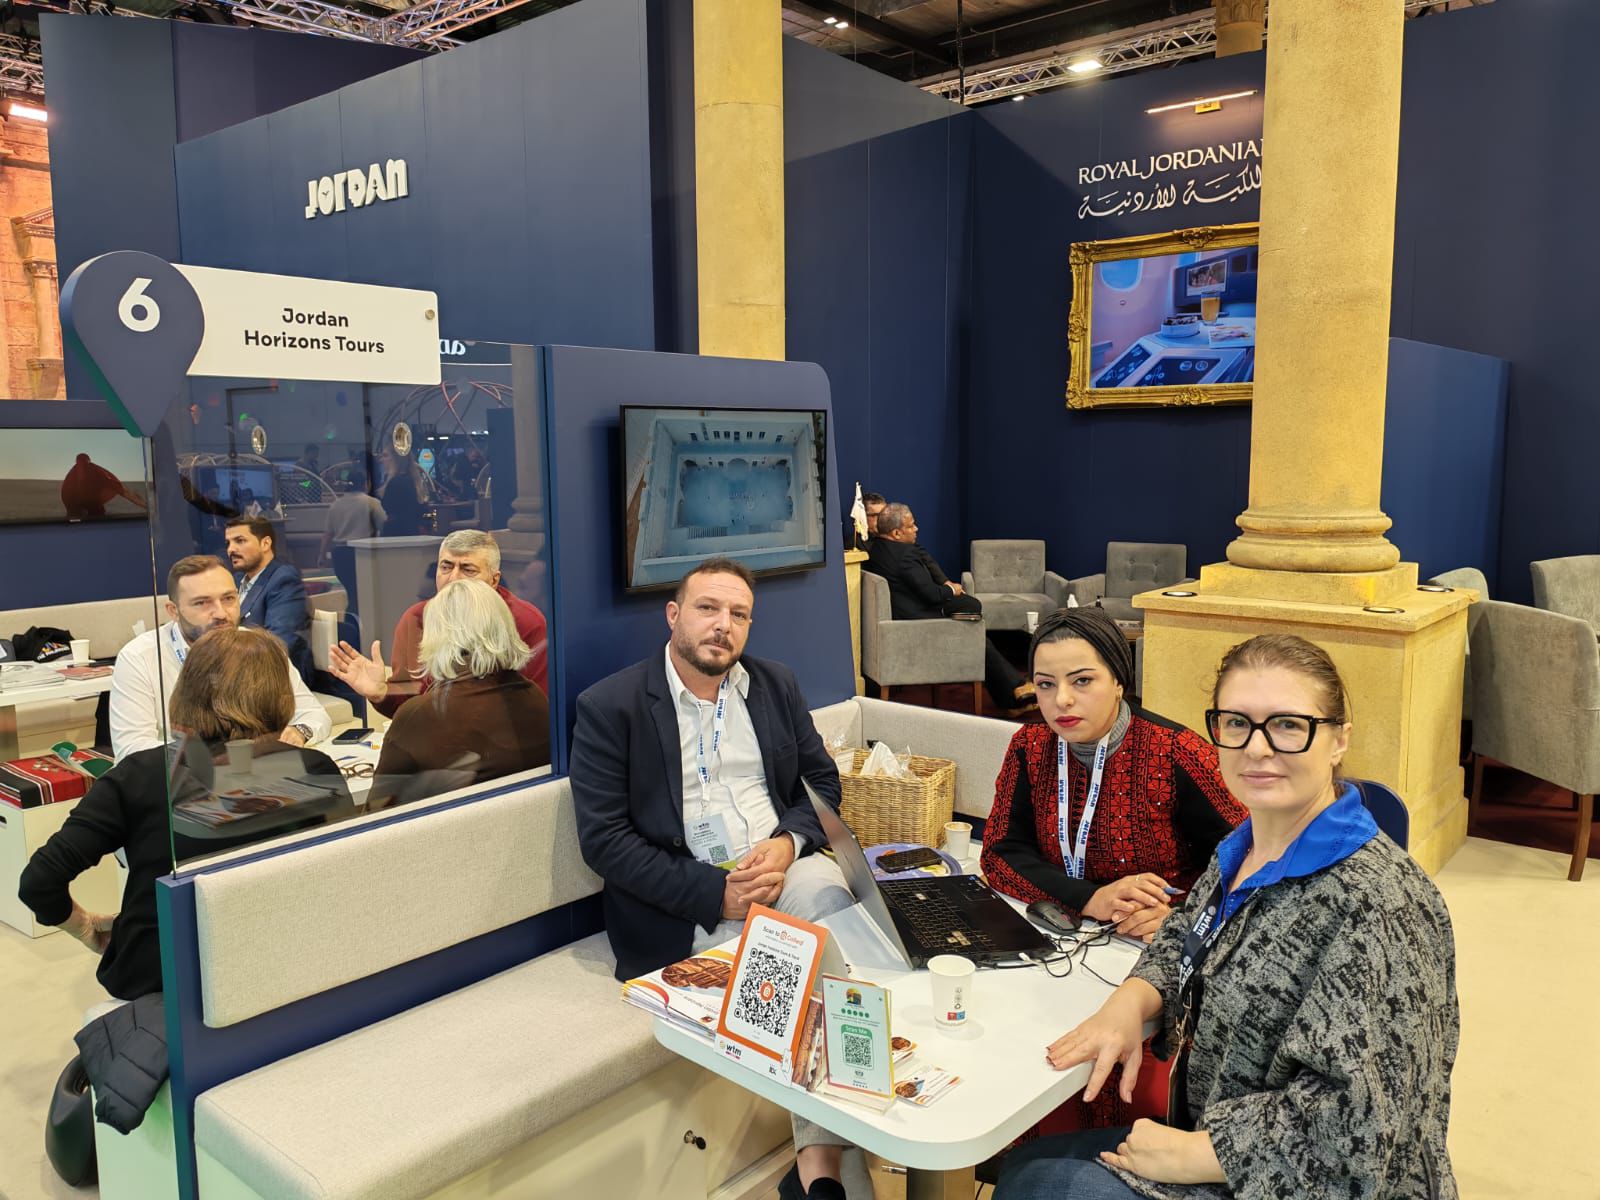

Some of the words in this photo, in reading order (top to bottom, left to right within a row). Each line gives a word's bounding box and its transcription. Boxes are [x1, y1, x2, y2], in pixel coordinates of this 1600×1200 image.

[1078, 159, 1142, 185] ROYAL
[118, 277, 161, 333] 6
[282, 308, 349, 328] Jordan
[244, 330, 331, 351] Horizons
[335, 335, 385, 354] Tours
[1196, 915, 1213, 936] wtm
[726, 1044, 742, 1056] wtm
